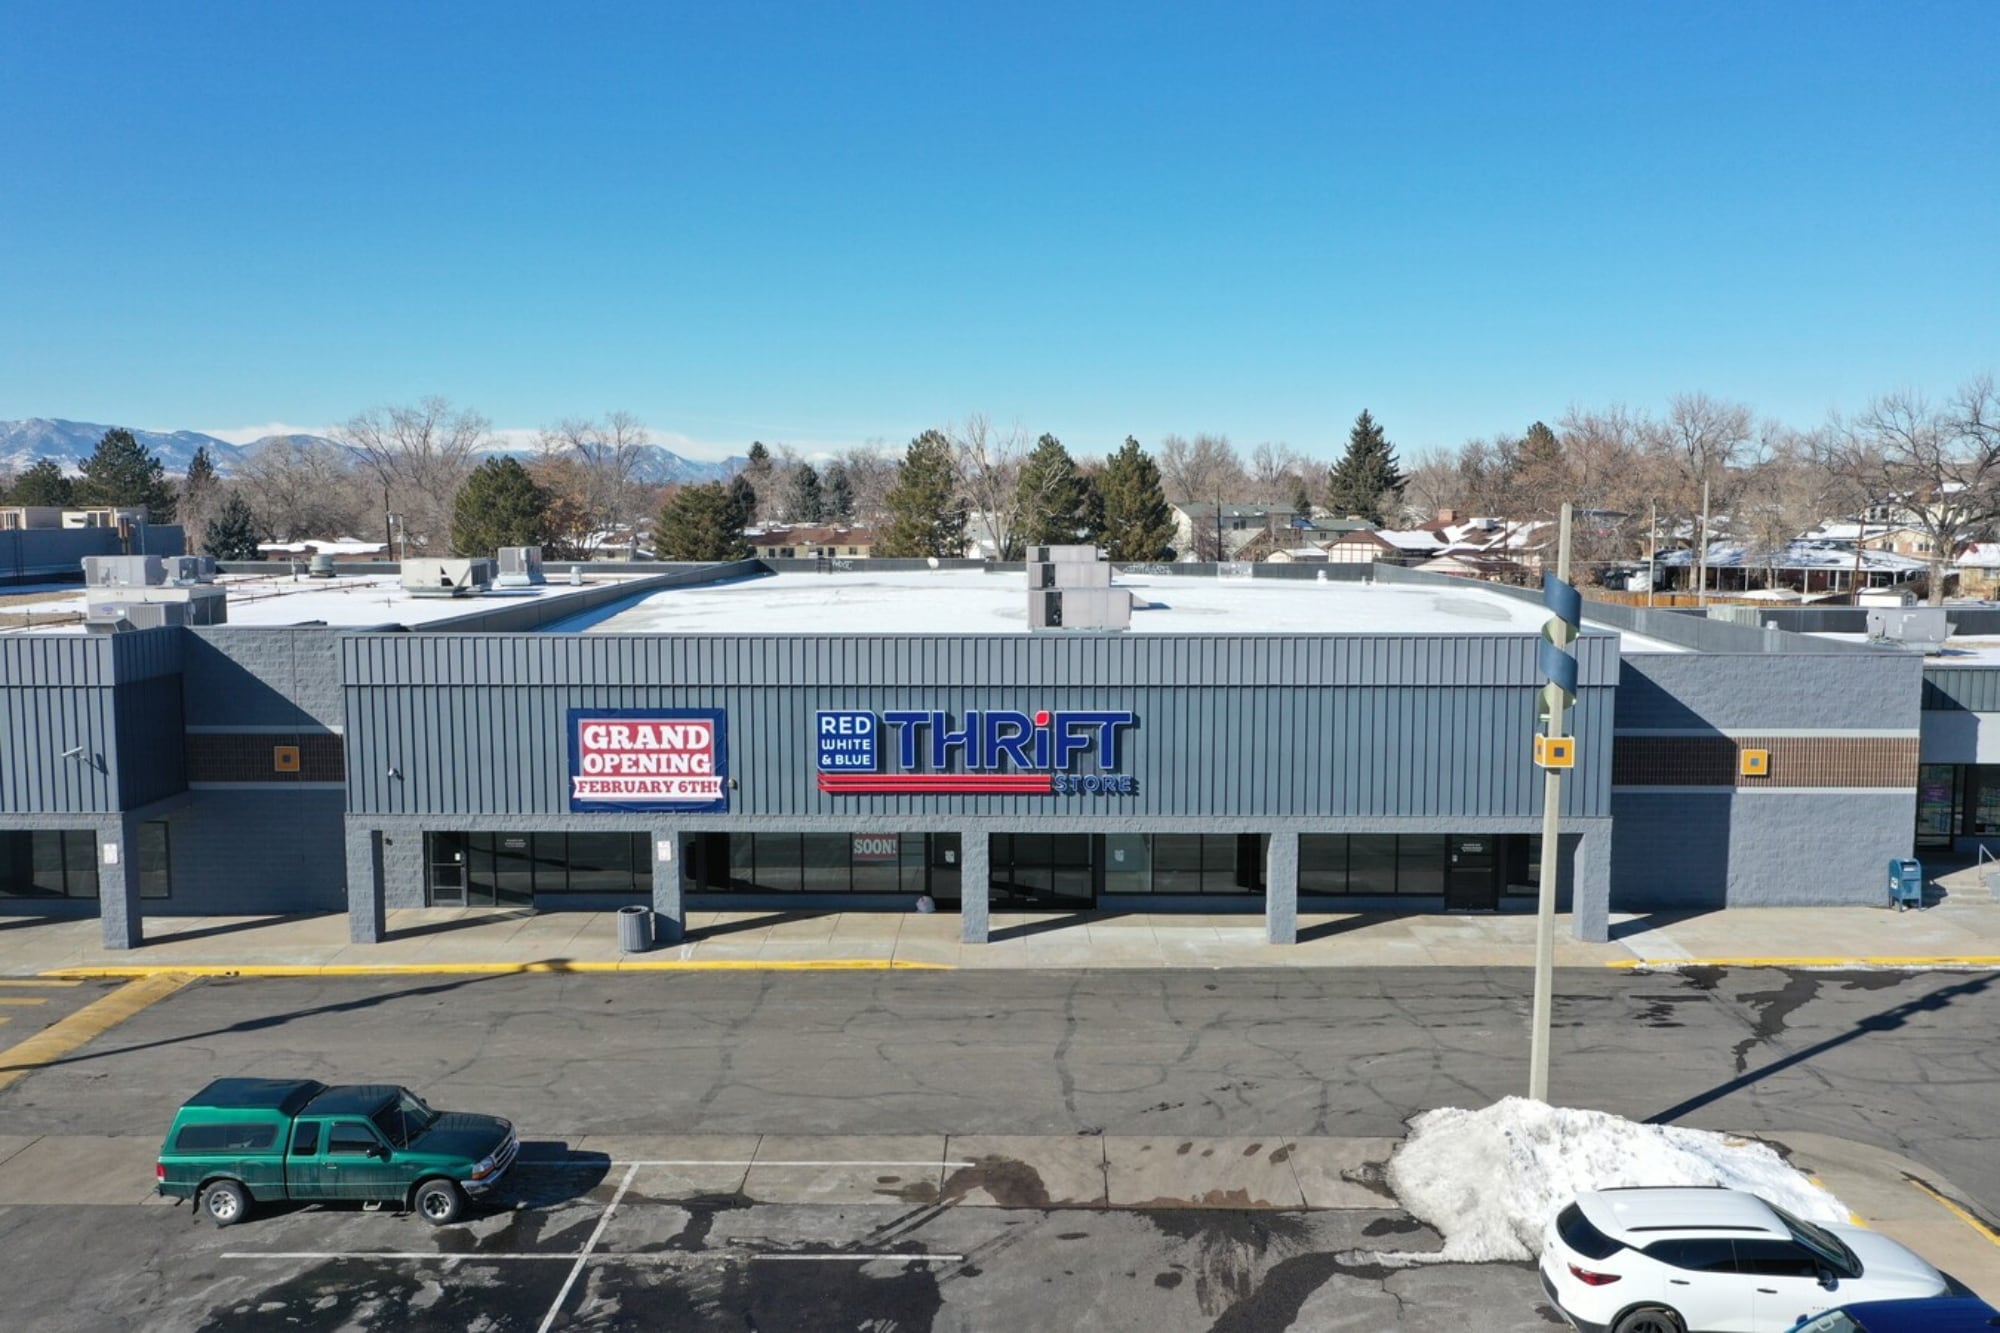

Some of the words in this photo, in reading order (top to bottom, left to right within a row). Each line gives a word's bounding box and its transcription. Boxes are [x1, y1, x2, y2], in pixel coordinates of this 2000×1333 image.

[821, 716, 871, 734] RED
[583, 725, 710, 749] GRAND
[821, 739, 871, 750] WHITE
[583, 753, 711, 774] OPENING
[821, 754, 832, 765] &
[835, 754, 871, 765] BLUE
[577, 780, 674, 793] FEBRUARY
[678, 780, 718, 793] 6TH!
[1055, 774, 1132, 791] STORE
[853, 838, 897, 855] SOON!
